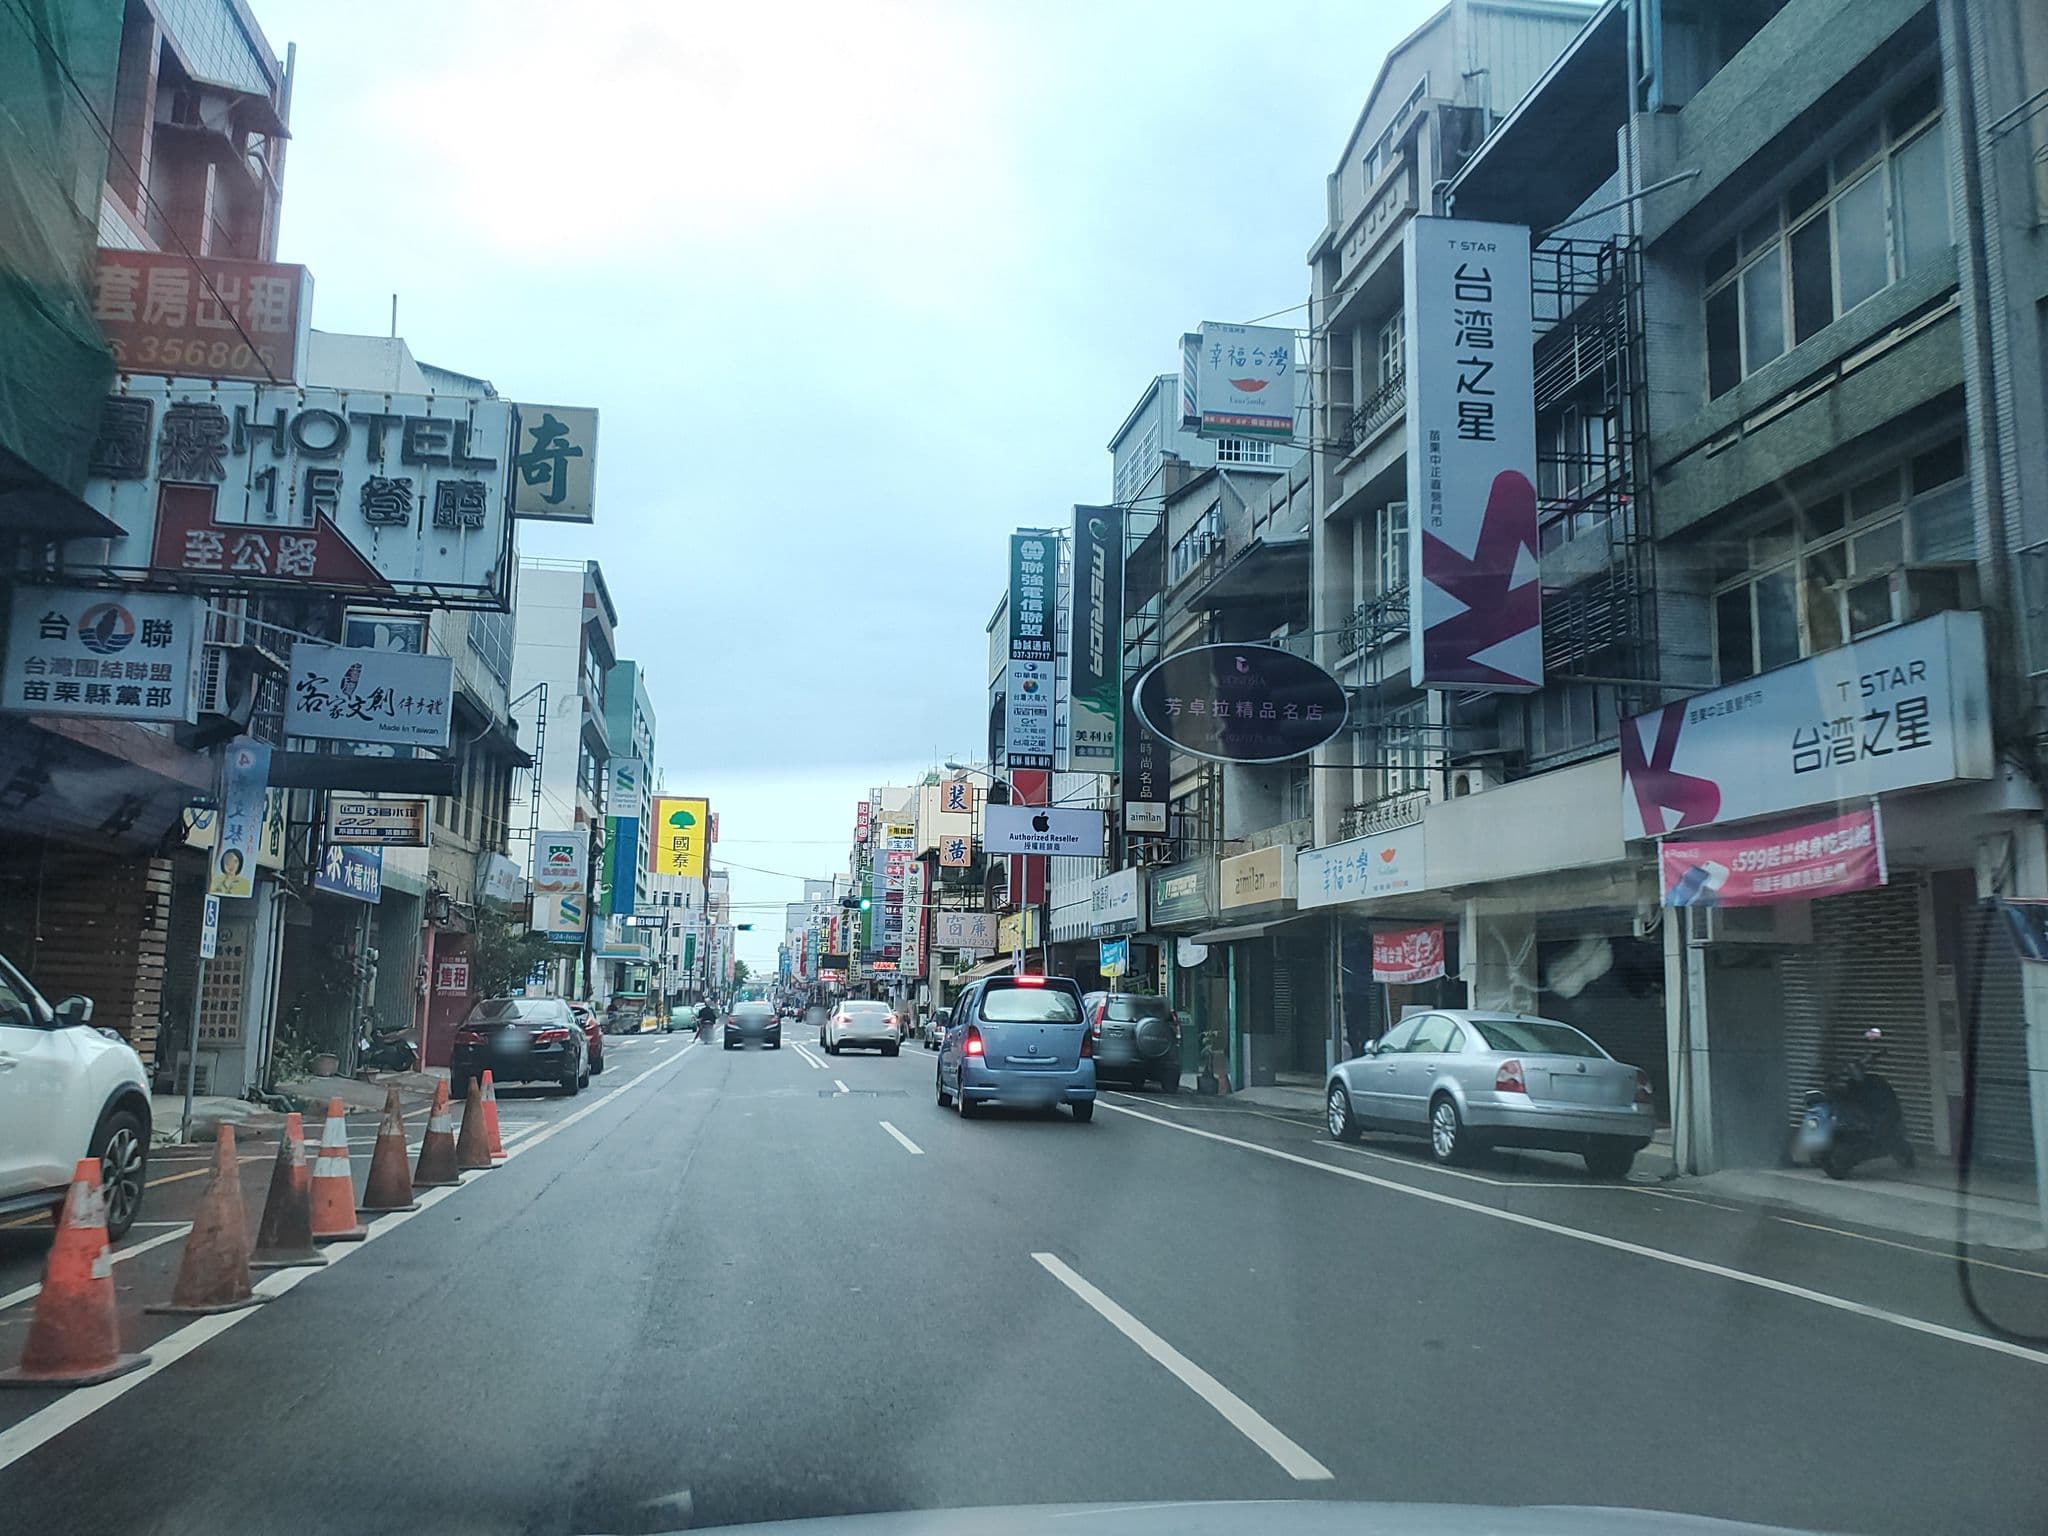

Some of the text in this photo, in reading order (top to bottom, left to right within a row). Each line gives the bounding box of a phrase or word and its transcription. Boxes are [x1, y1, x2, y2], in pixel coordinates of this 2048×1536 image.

[1461, 241, 1497, 253] STAR
[95, 266, 292, 335] 套房出租
[1209, 342, 1289, 376] 幸福台灣
[231, 404, 497, 472] HOTEL
[518, 414, 582, 505] 奇
[360, 473, 487, 531] 餐廳
[183, 529, 318, 577] 至公路
[1020, 561, 1044, 636] 聯強電信聯盟
[40, 611, 173, 649] 台 聯
[24, 656, 172, 683] 台灣團結聯盟
[1860, 659, 1927, 699] STAR
[23, 681, 172, 709] 苗栗縣黨部
[296, 672, 395, 722] 客家文創
[1165, 698, 1324, 722] 芳卓拉精品名店
[379, 722, 401, 732] Made
[411, 725, 439, 735] Taiwan
[945, 784, 968, 864] 裝 潢
[1130, 813, 1162, 822] aimilan
[1009, 833, 1079, 843] Authorized Reseller
[344, 860, 379, 896] 水電材料
[1235, 867, 1266, 895] aimilan
[946, 915, 988, 938] 窗簾
